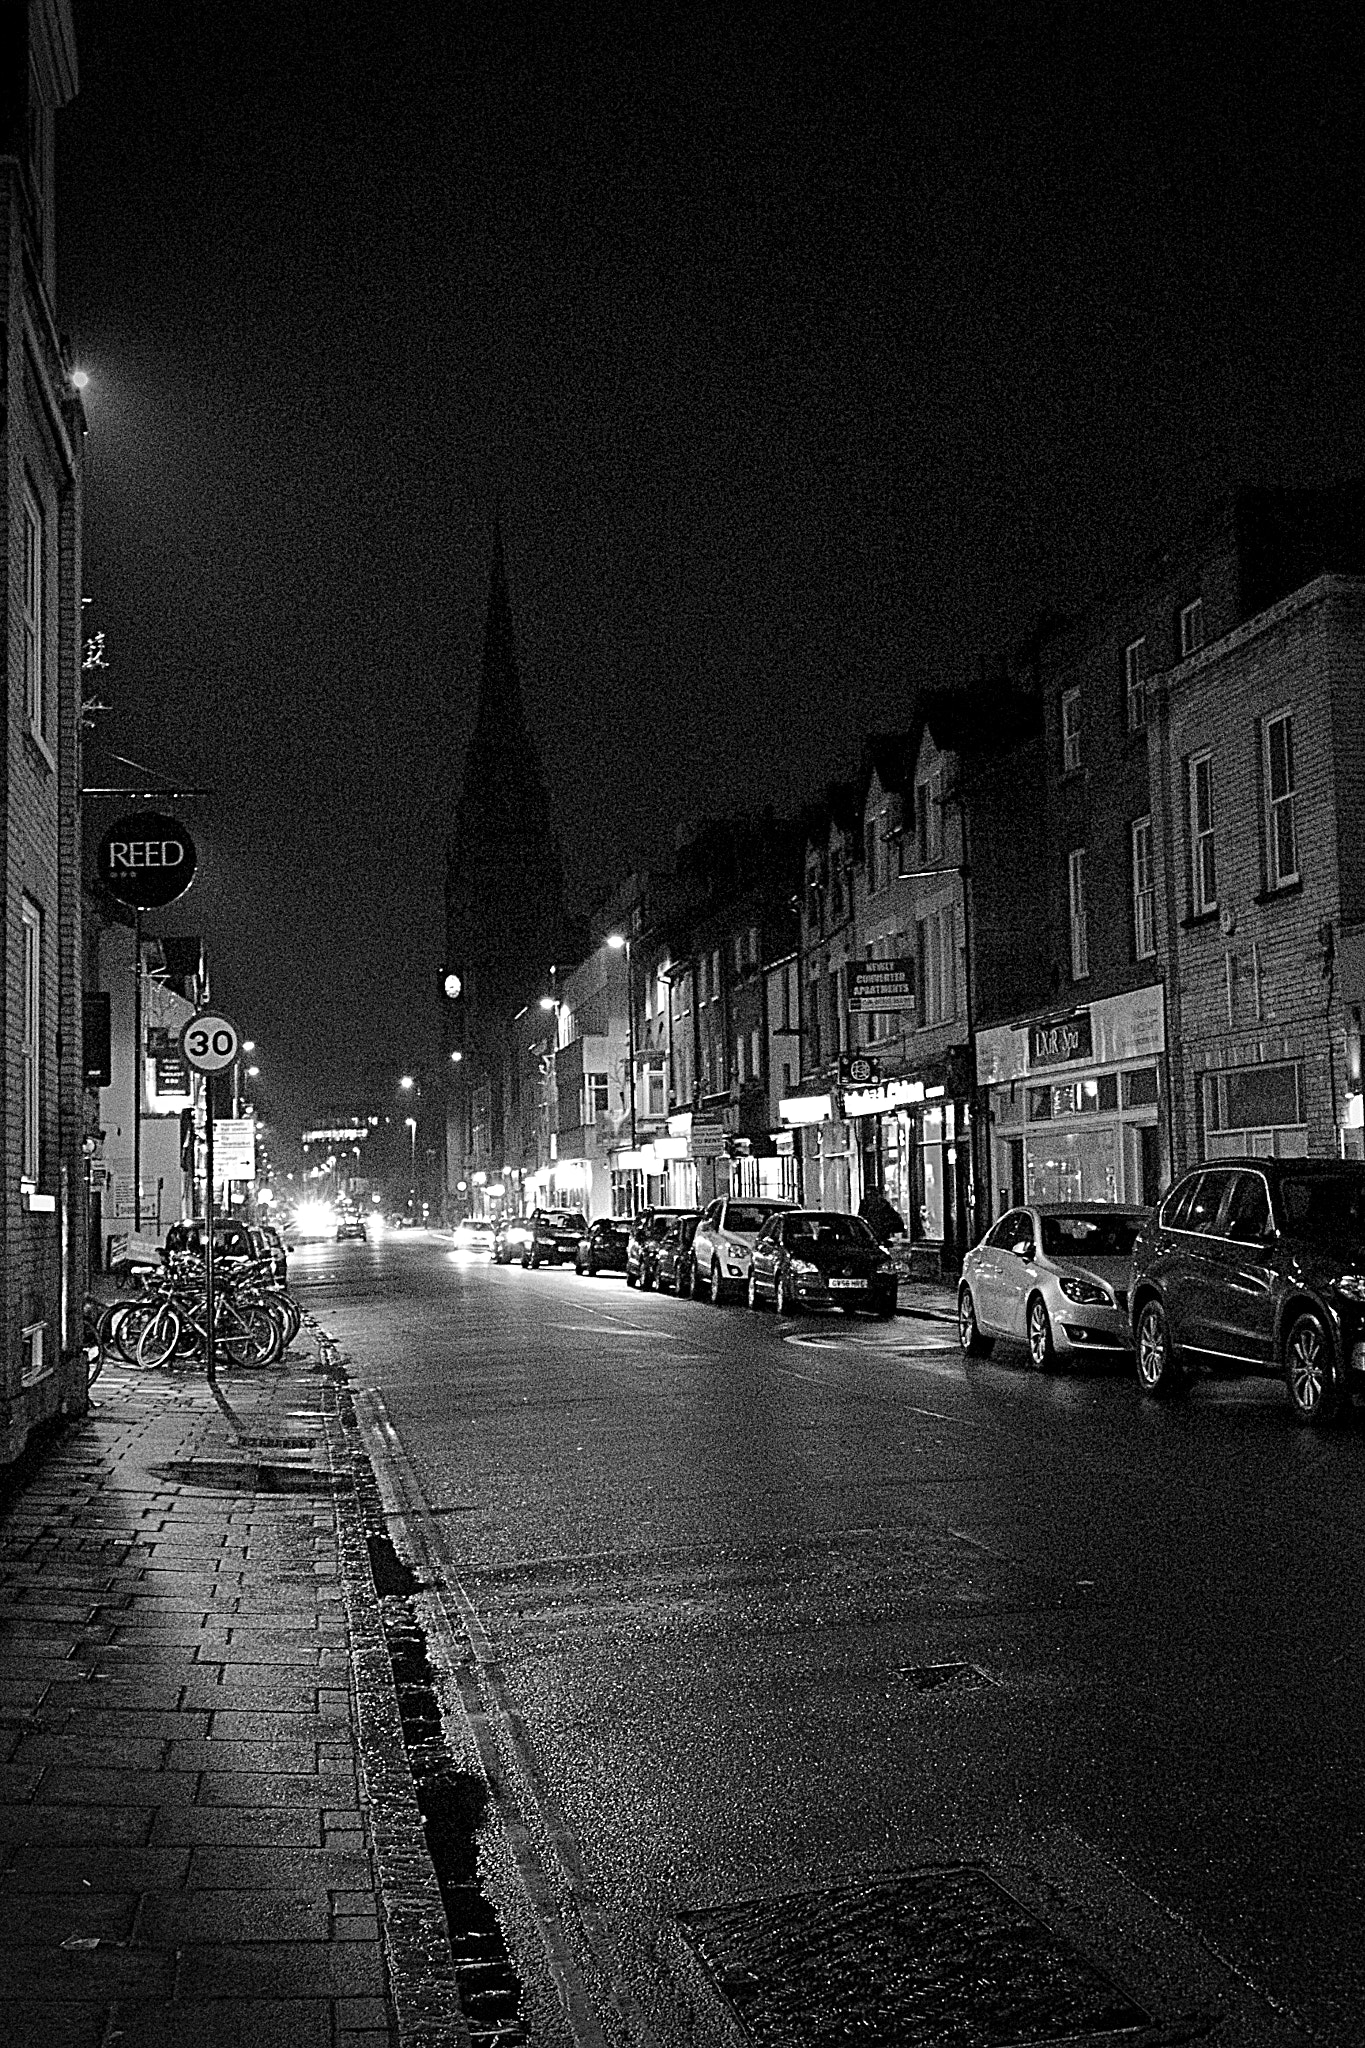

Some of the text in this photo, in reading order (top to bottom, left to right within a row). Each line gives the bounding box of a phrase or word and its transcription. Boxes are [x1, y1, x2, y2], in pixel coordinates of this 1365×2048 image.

[110, 840, 184, 867] REED
[853, 983, 910, 996] APARTMENTS
[189, 1030, 234, 1056] 30
